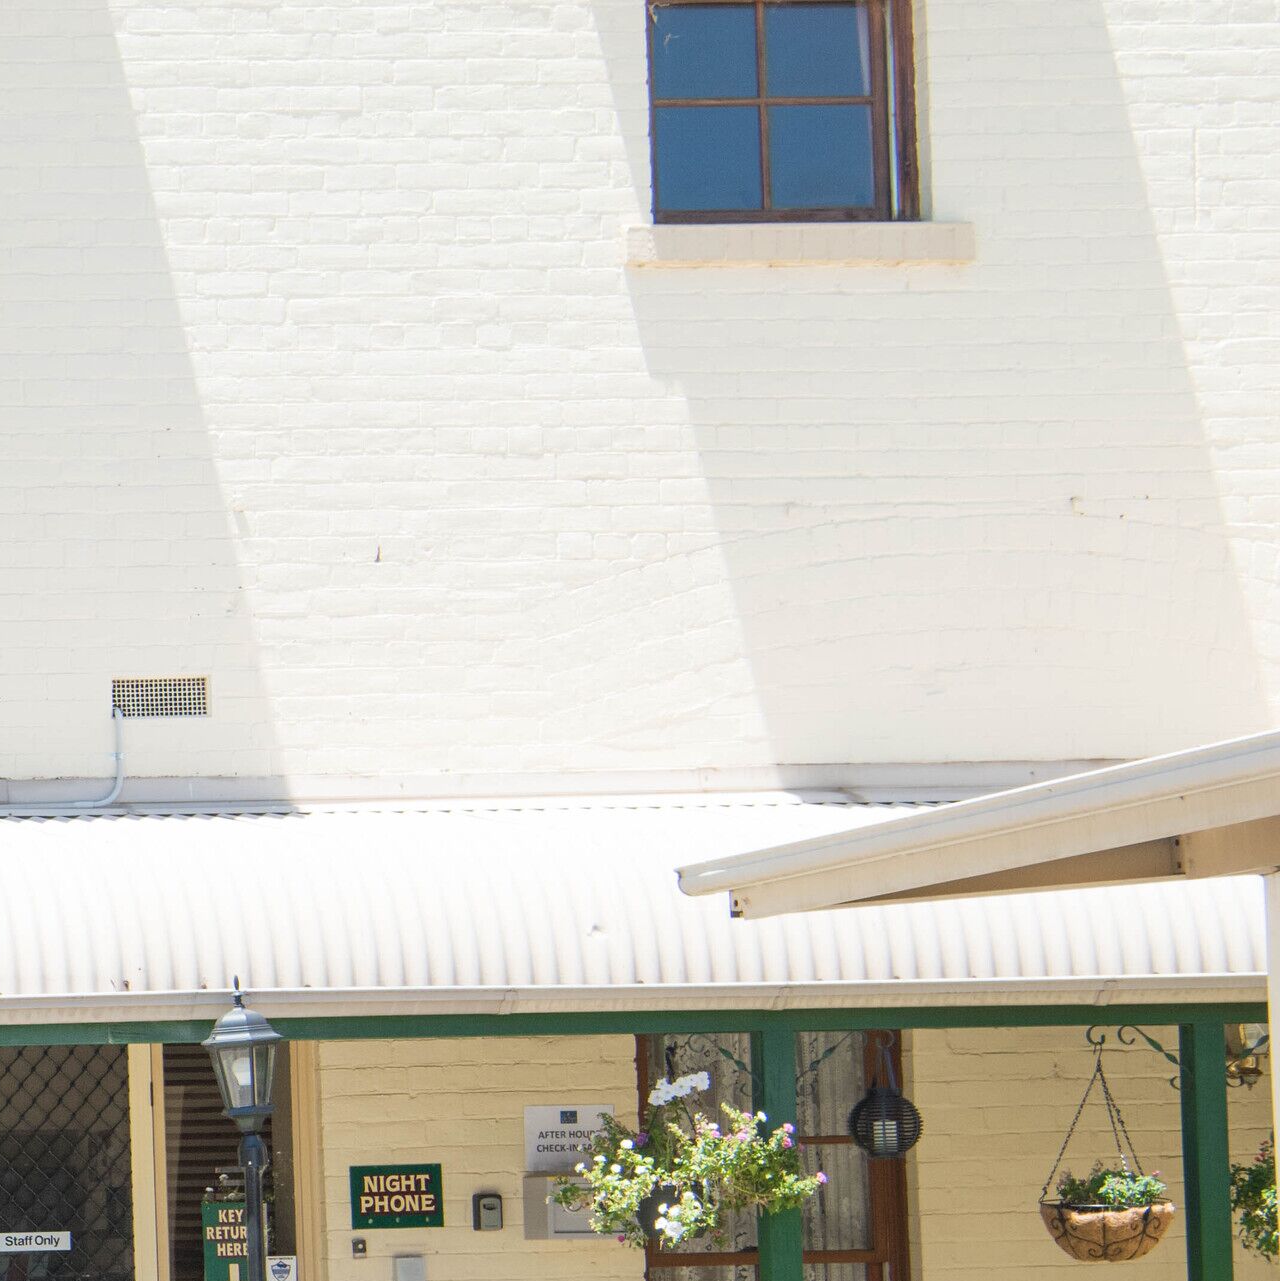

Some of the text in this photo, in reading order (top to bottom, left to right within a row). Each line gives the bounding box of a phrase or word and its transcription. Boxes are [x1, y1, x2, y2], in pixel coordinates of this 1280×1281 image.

[538, 1130, 566, 1140] AFTER
[536, 1144, 579, 1153] CHECK-IN
[363, 1174, 430, 1193] NIGHT
[360, 1194, 435, 1214] PHONE
[218, 1209, 243, 1223] KEY
[206, 1226, 247, 1240] RETUR
[5, 1235, 60, 1248] Staff Only
[217, 1243, 249, 1257] HERE
